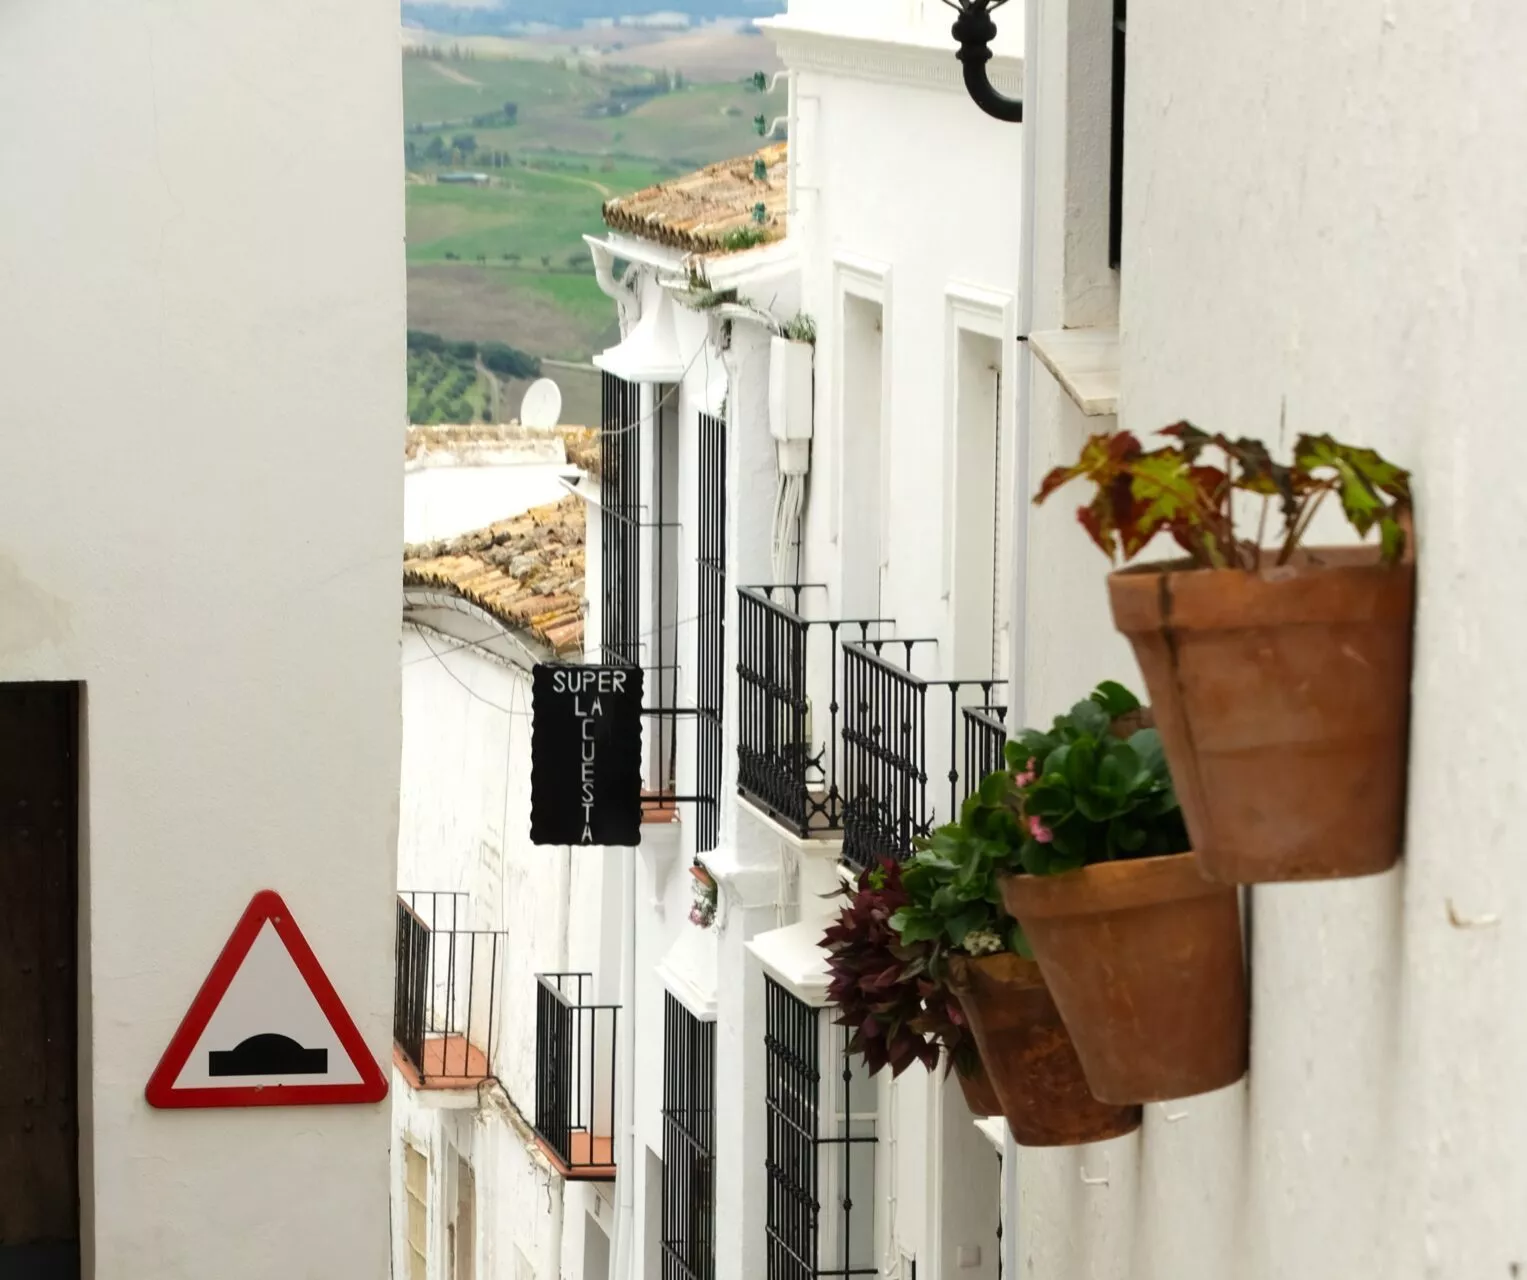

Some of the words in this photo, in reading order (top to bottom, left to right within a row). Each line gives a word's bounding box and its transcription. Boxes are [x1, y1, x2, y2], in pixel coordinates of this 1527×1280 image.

[552, 670, 627, 693] SUPER
[574, 695, 603, 717] LA
[581, 718, 595, 842] CUESTA
